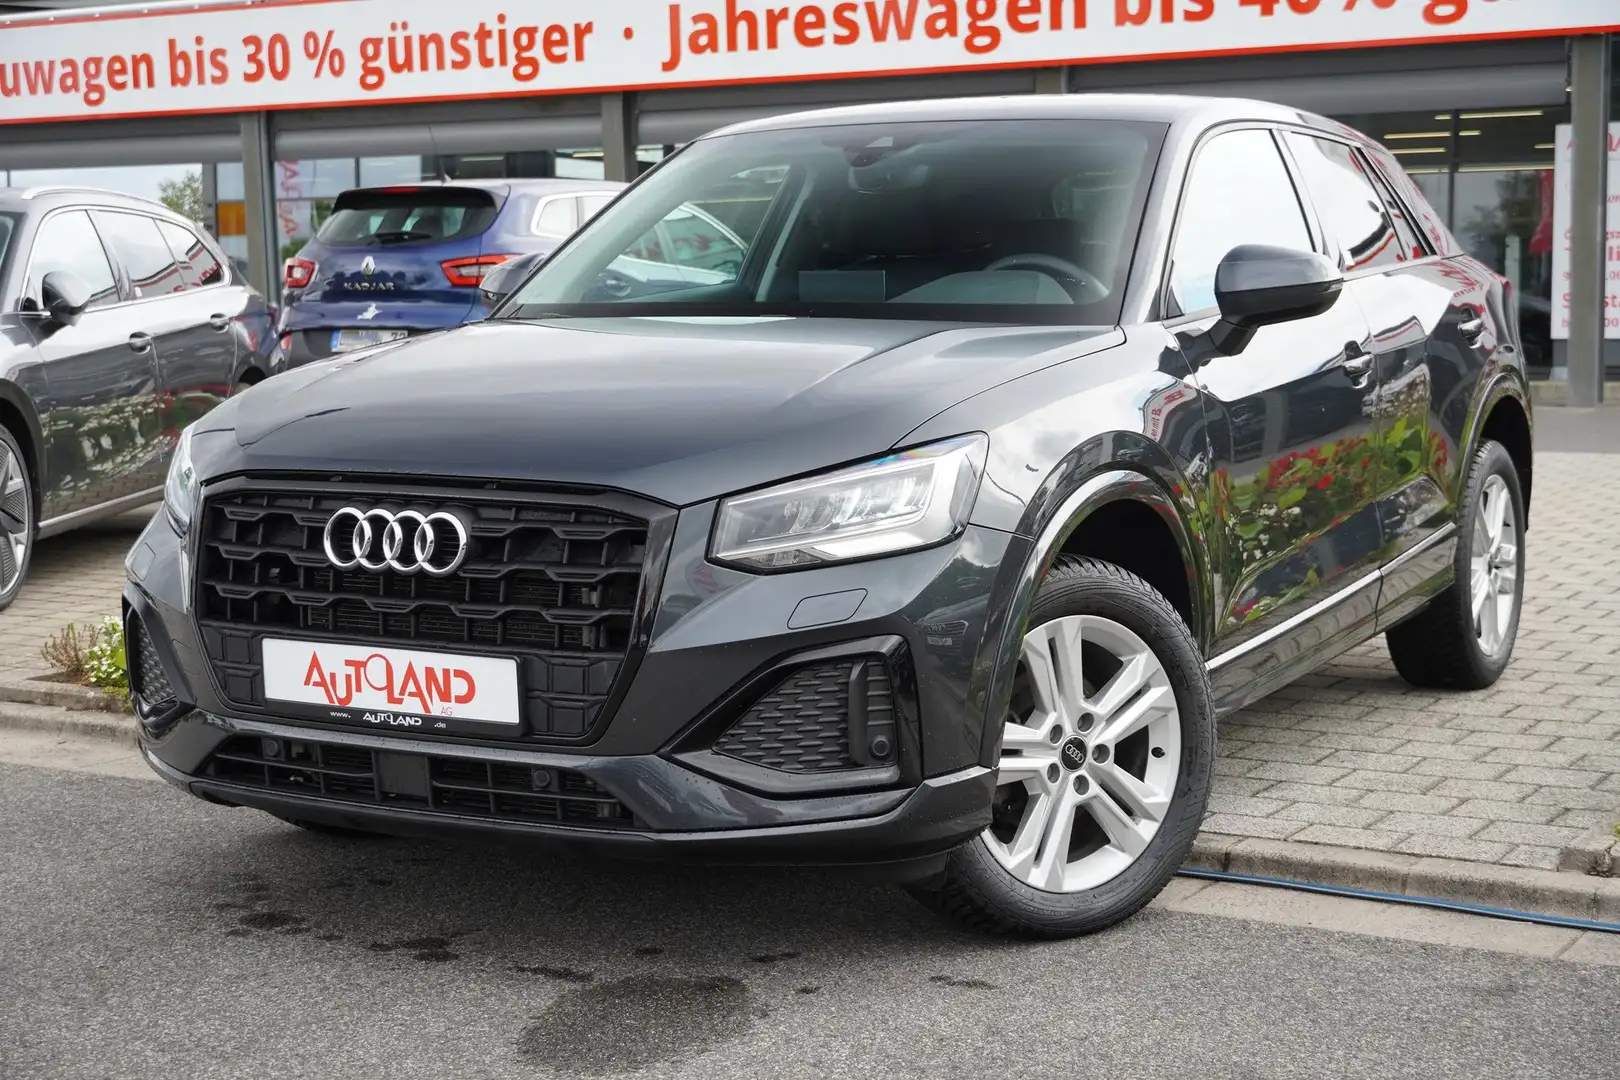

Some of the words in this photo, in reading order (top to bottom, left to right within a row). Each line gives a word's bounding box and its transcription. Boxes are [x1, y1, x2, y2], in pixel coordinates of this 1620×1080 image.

[168, 36, 229, 87] bis
[242, 33, 290, 83] 30
[304, 30, 345, 79] %
[360, 13, 594, 92] günstiger
[661, 0, 1088, 73] Jahreswagen
[344, 282, 395, 291] KADJAR
[440, 707, 453, 716] AG
